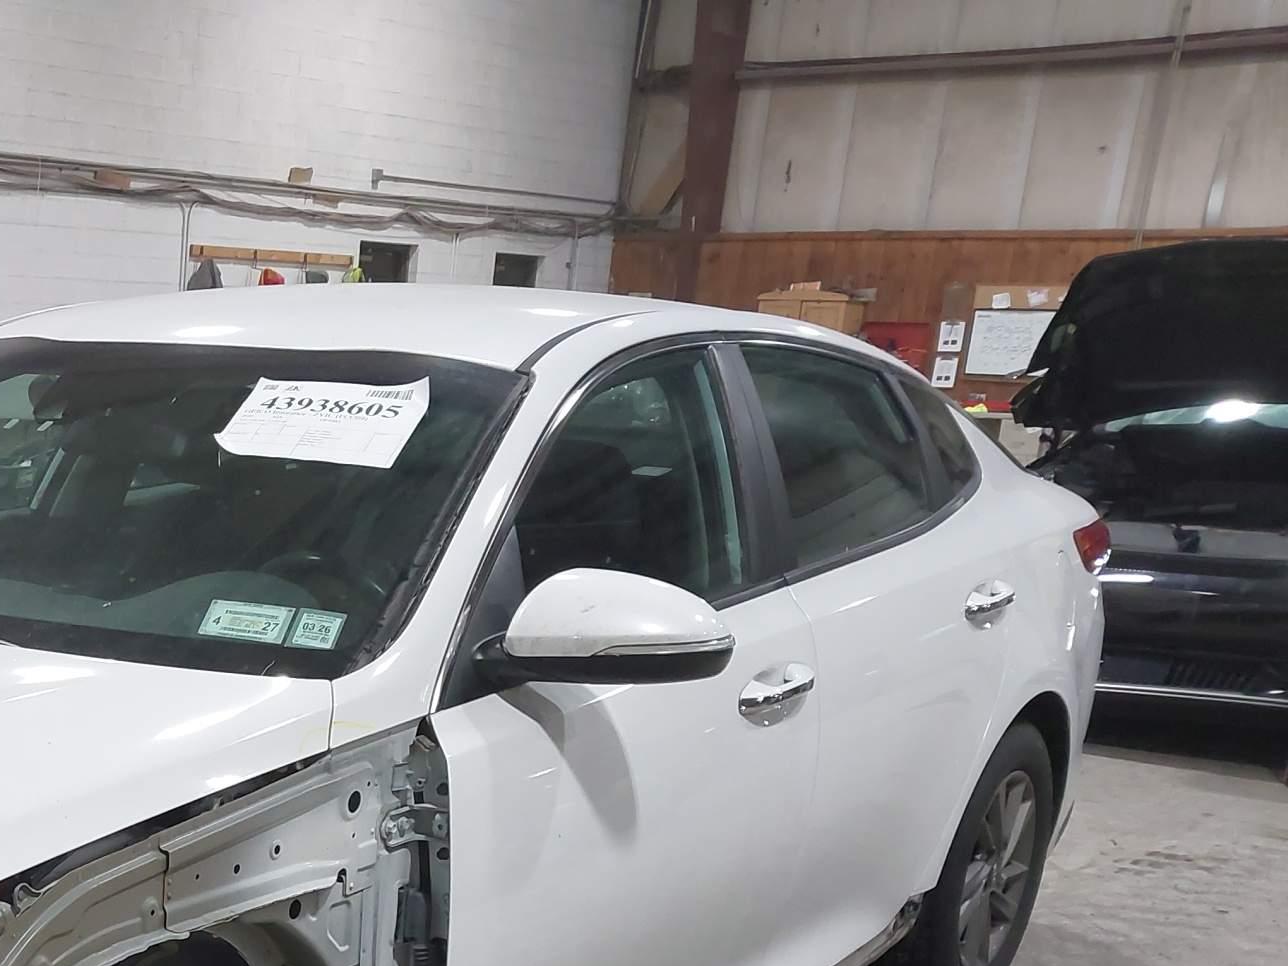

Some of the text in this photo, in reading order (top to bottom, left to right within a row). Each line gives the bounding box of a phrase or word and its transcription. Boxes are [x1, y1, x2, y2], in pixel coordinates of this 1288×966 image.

[260, 396, 404, 419] 43938605
[212, 615, 222, 626] 4
[261, 621, 279, 632] 27
[302, 622, 331, 634] 03 26
